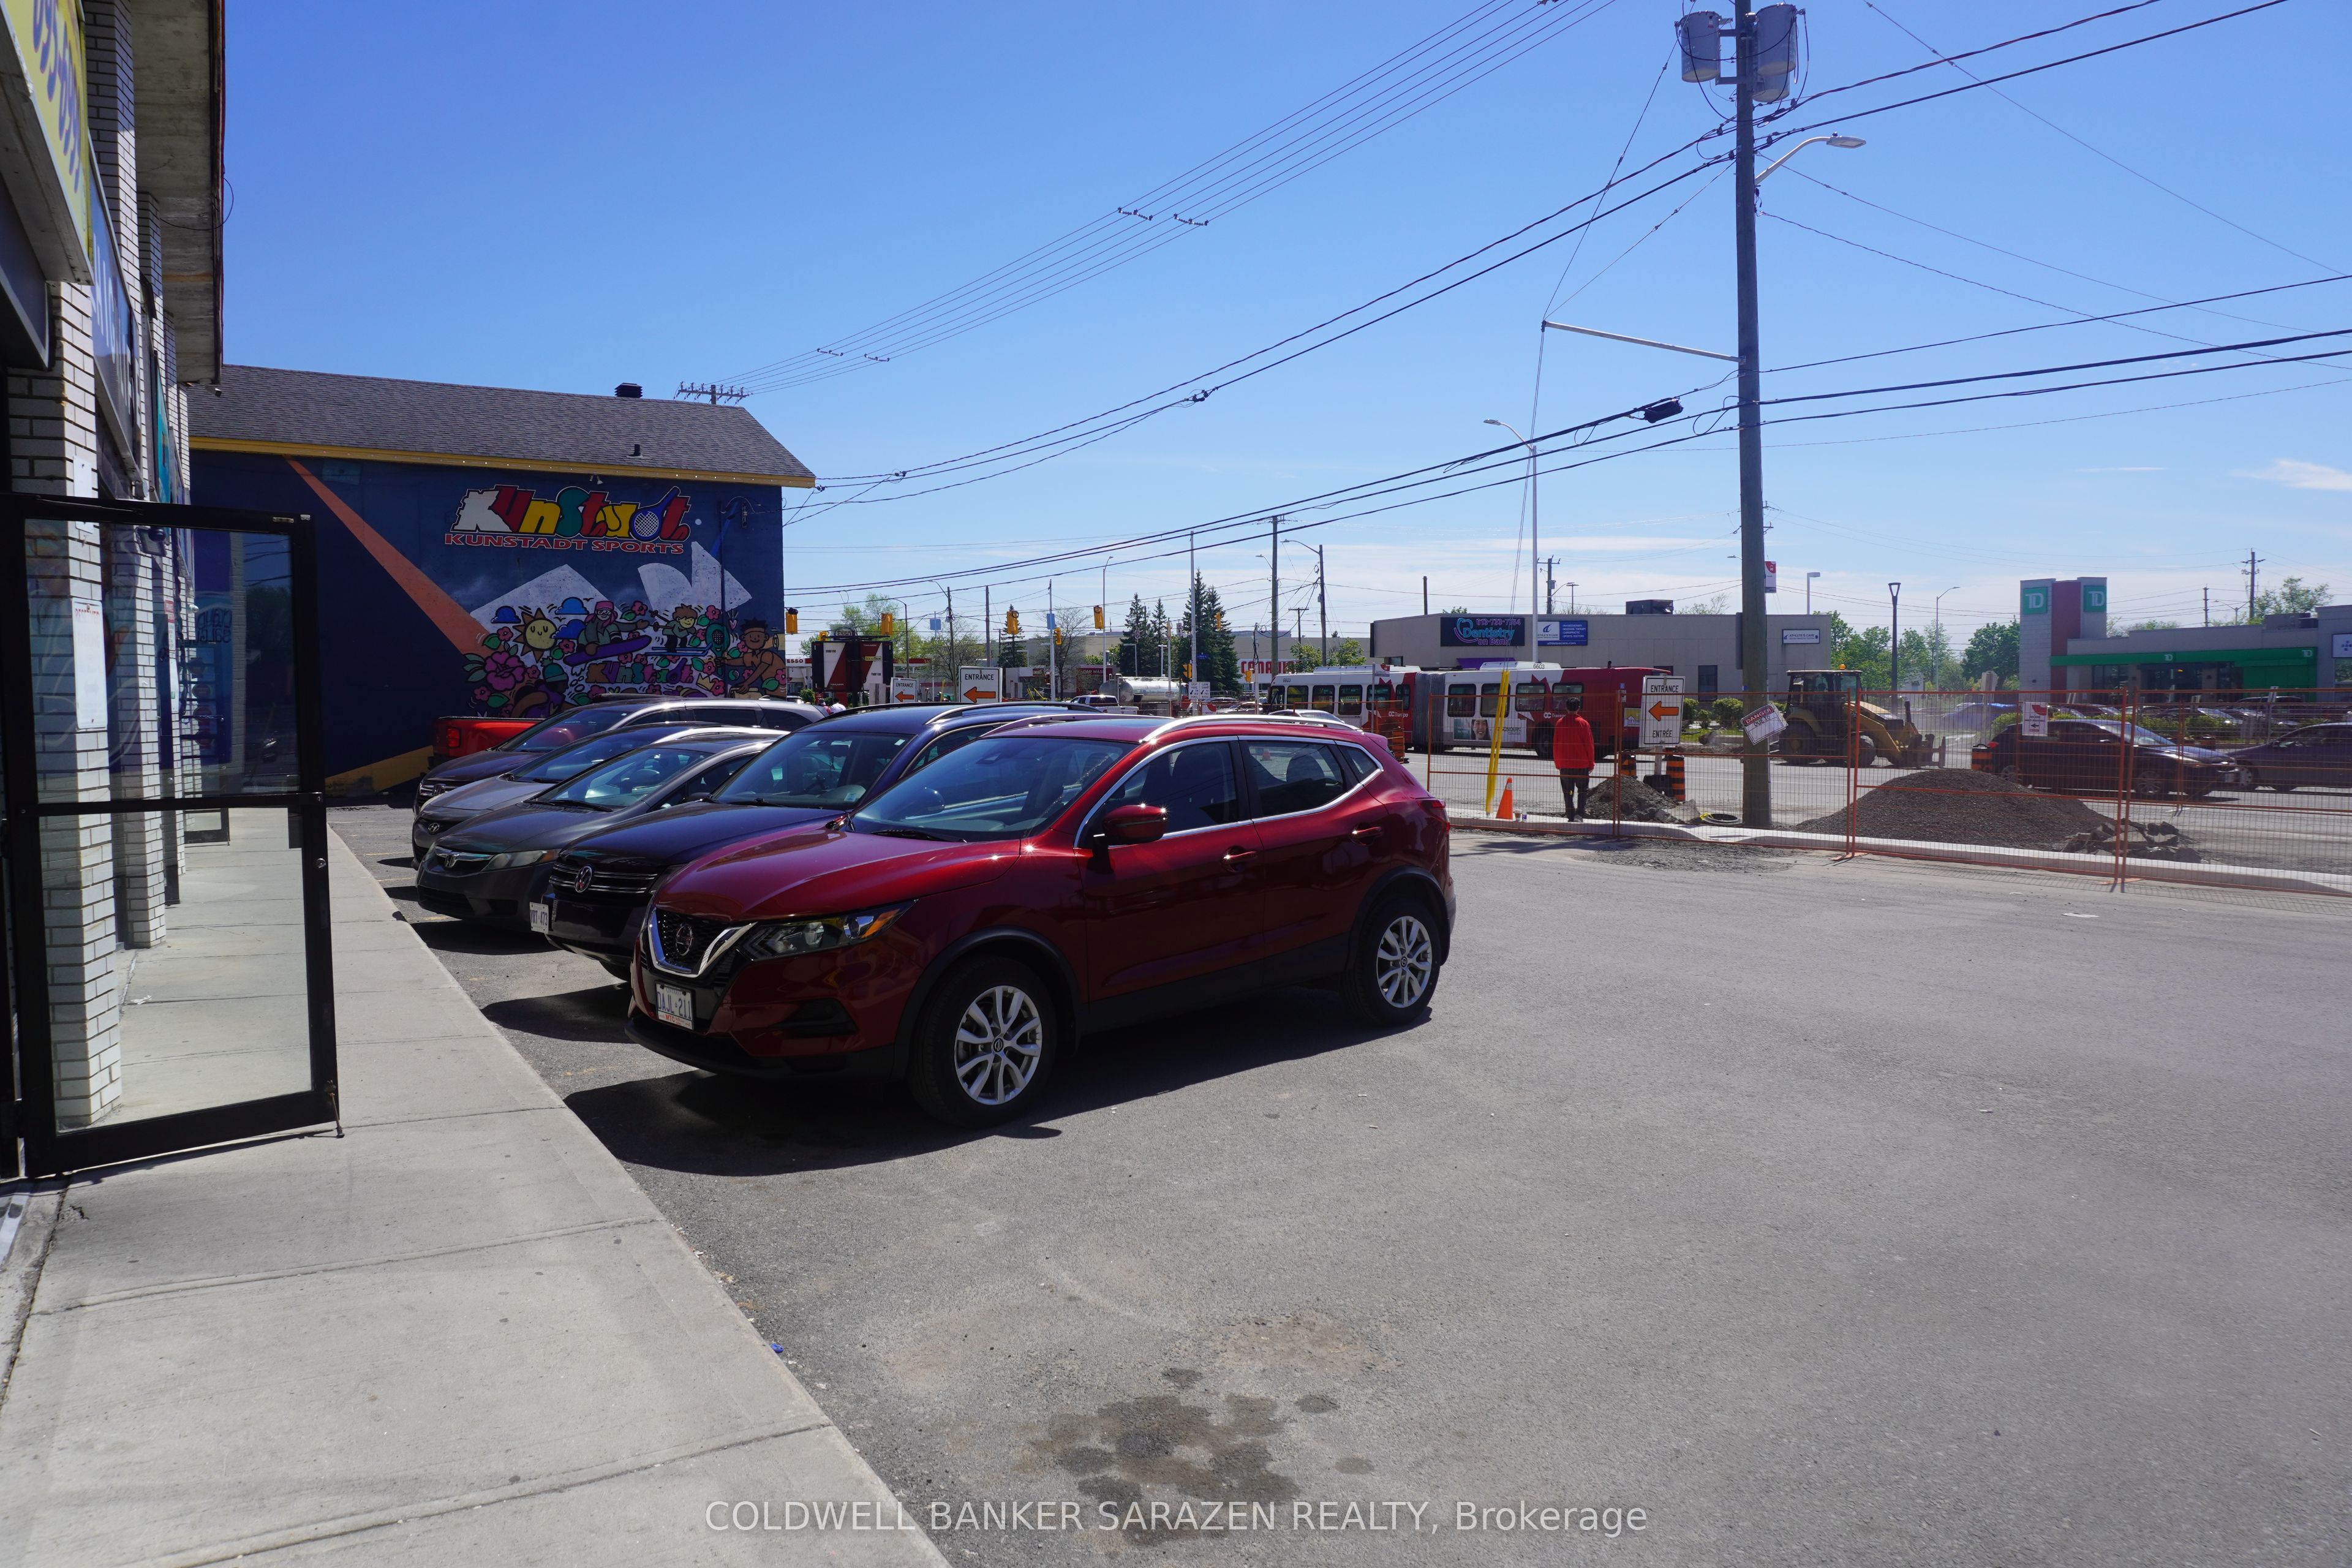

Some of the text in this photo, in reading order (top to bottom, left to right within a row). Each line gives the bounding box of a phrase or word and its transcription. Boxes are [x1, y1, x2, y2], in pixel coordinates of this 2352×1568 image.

[445, 533, 684, 554] KUNSTADT SPORTS
[2024, 592, 2044, 609] TD
[2088, 591, 2105, 606] TD
[1463, 627, 1515, 641] Dentistry
[1746, 708, 1772, 724] DANGER
[1754, 718, 1764, 726] DUE
[1653, 728, 1673, 738] ENTRÉE
[657, 991, 692, 1020] DAJL 211
